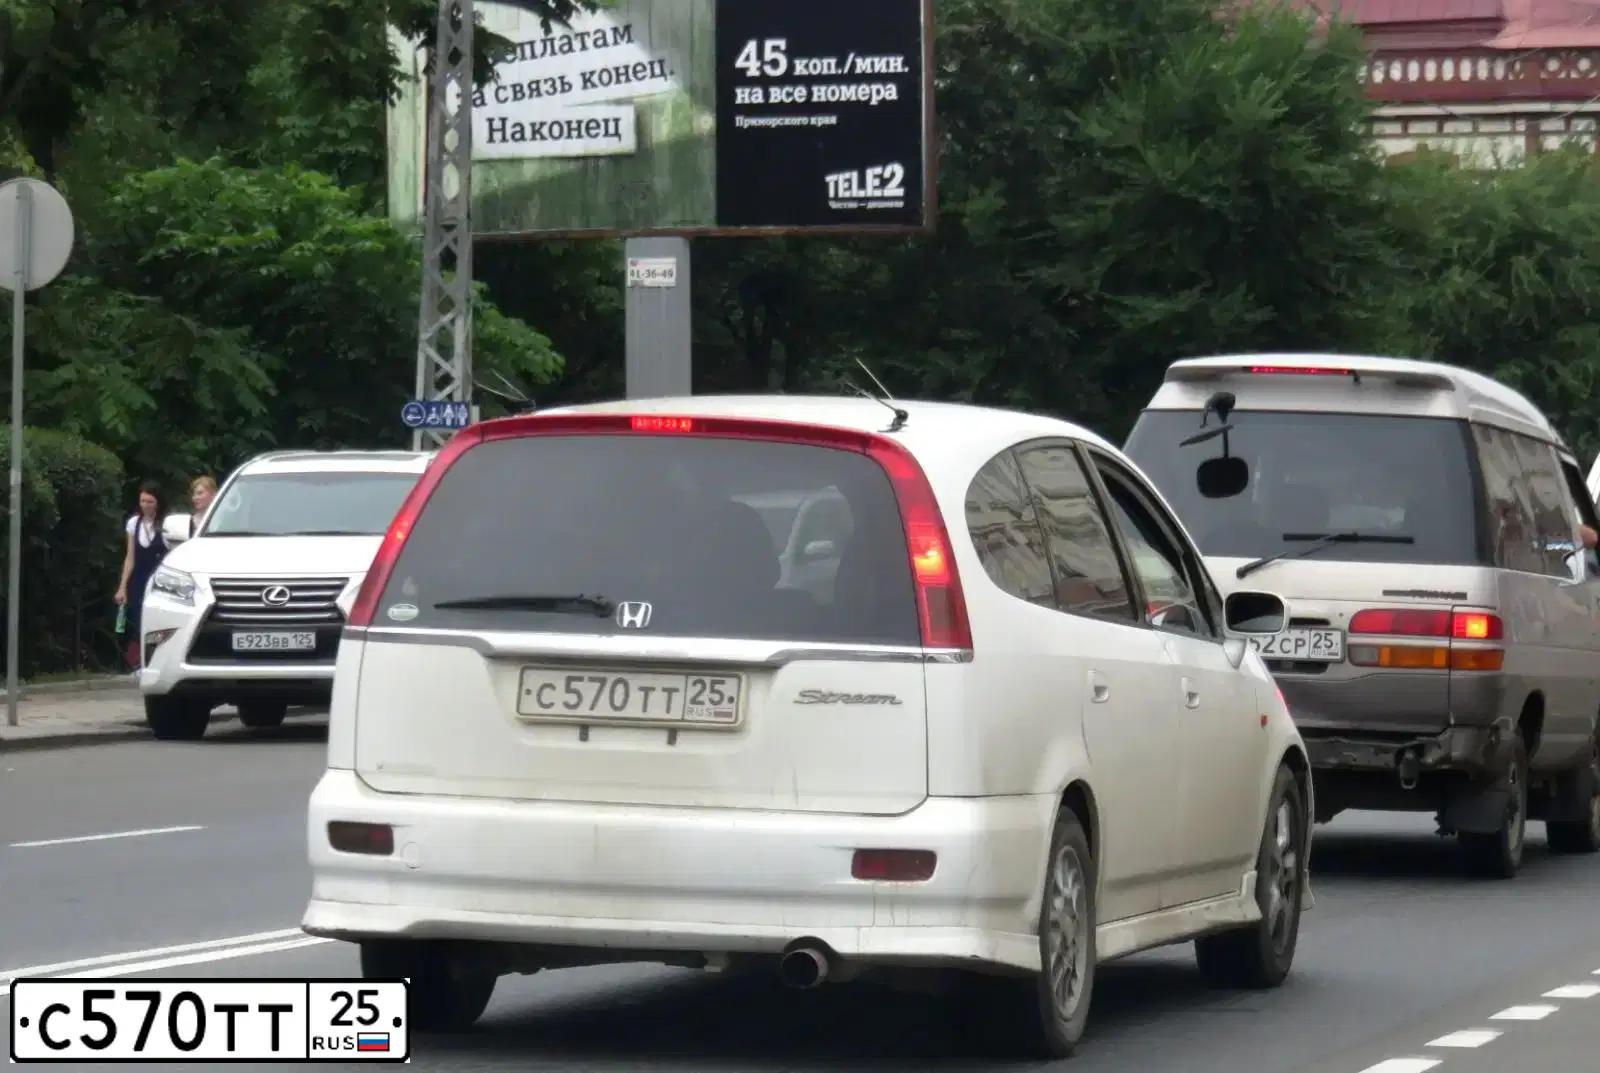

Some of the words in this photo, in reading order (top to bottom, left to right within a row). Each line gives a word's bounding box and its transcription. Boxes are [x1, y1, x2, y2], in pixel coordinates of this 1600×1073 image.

[735, 39, 788, 77] 45
[793, 52, 910, 76] коп./мин.
[494, 73, 573, 104] связь
[580, 58, 676, 90] конец.
[735, 86, 765, 104] на
[769, 84, 807, 103] все
[811, 82, 899, 105] номера
[485, 117, 622, 144] Наконец
[735, 115, 809, 129] Приморского
[824, 162, 905, 199] TELE2
[292, 633, 313, 645] 125
[1312, 633, 1334, 650] 25
[689, 678, 727, 706] 25
